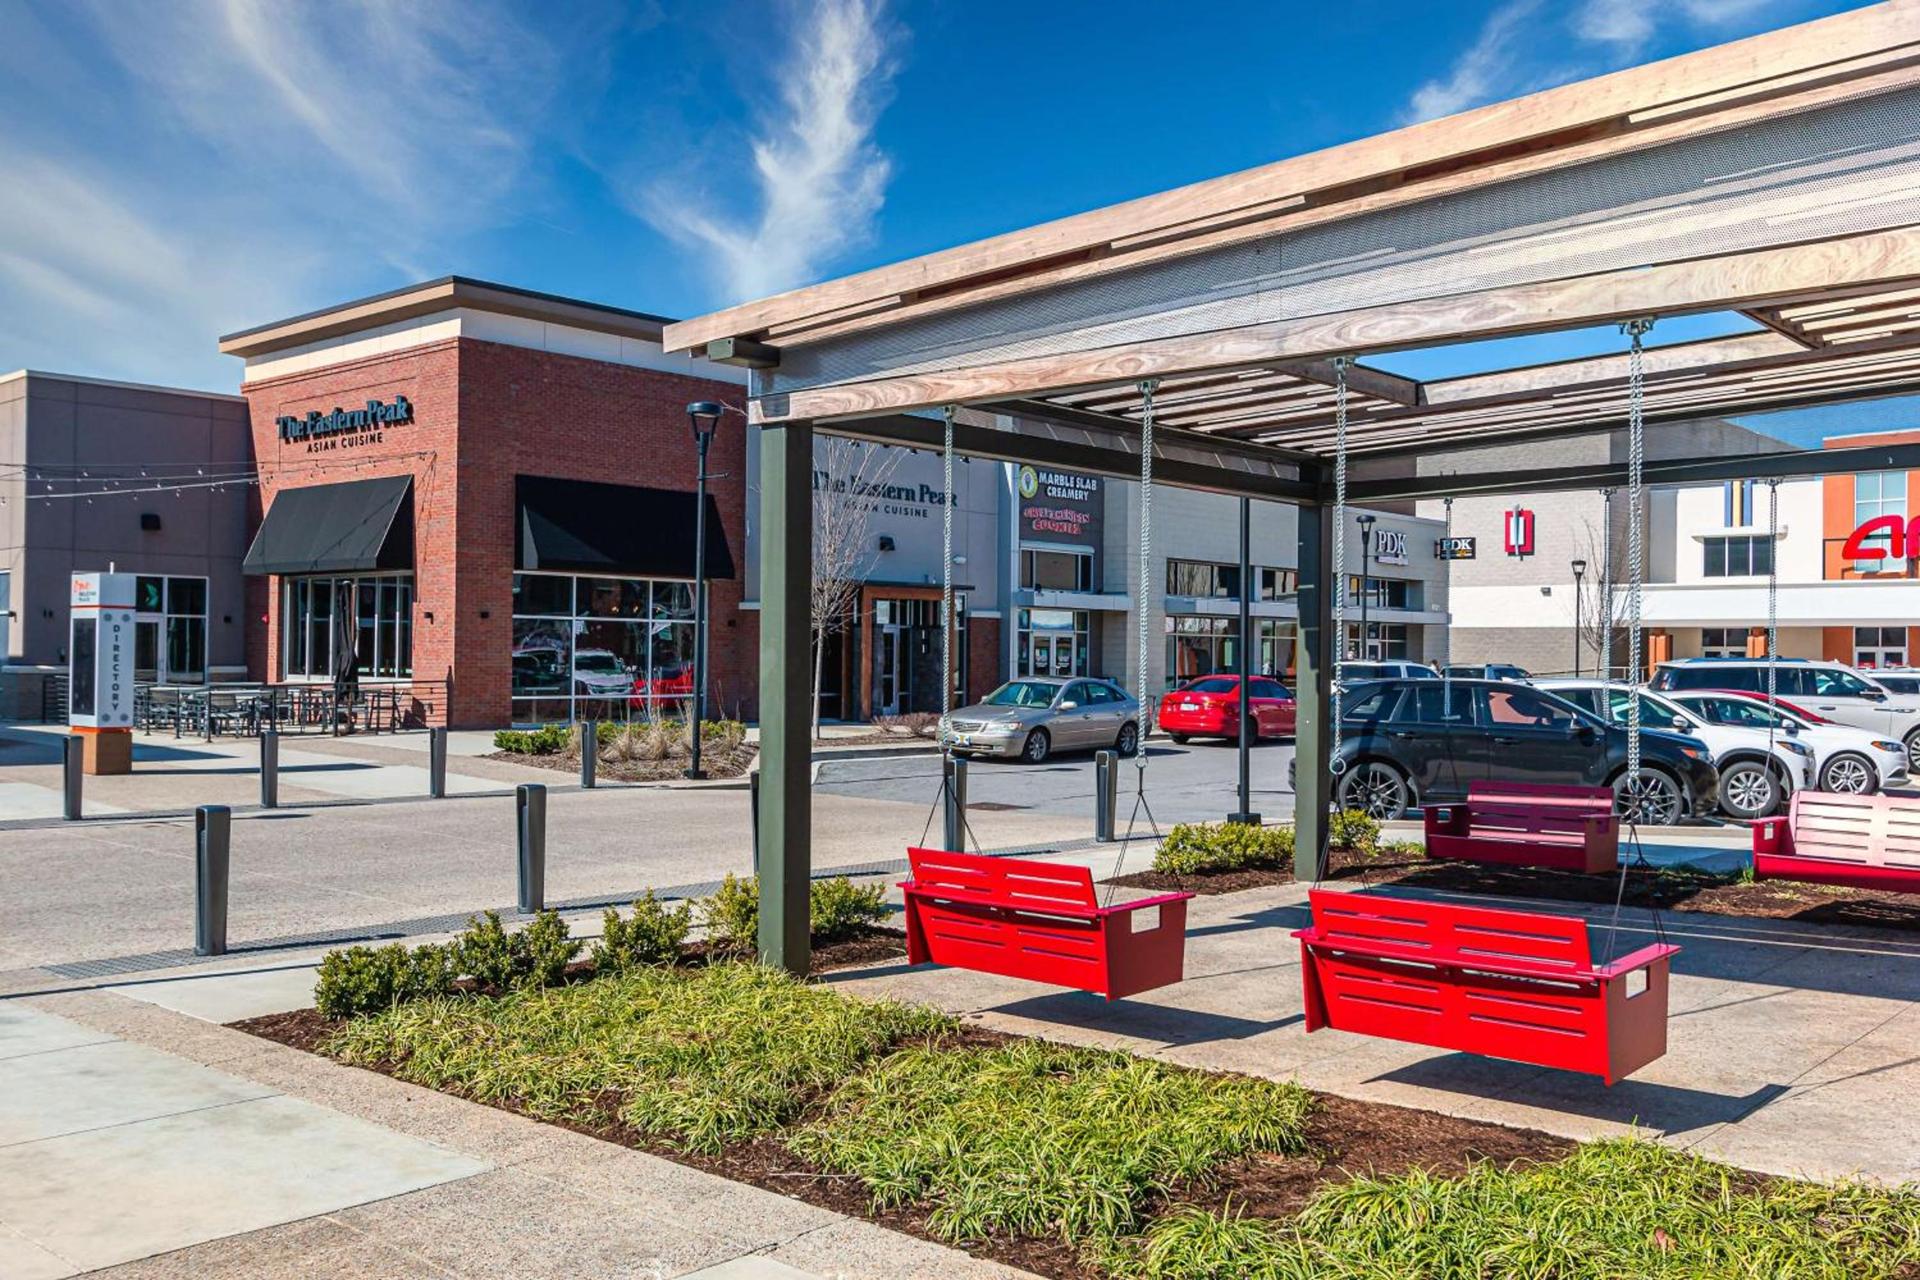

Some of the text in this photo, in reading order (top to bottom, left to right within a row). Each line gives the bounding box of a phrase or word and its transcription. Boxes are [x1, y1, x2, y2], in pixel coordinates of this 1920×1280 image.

[276, 395, 409, 440] The Eastern Peak
[307, 432, 384, 453] ASIAN CUISINE
[1039, 472, 1097, 491] MARBLE SLAB
[918, 483, 958, 507] Peak
[1046, 486, 1089, 501] CREAMERY
[884, 504, 929, 518] CUISINE
[1377, 530, 1407, 555] PDK
[1442, 538, 1473, 551] PDK
[112, 624, 120, 711] DIRECTORY
